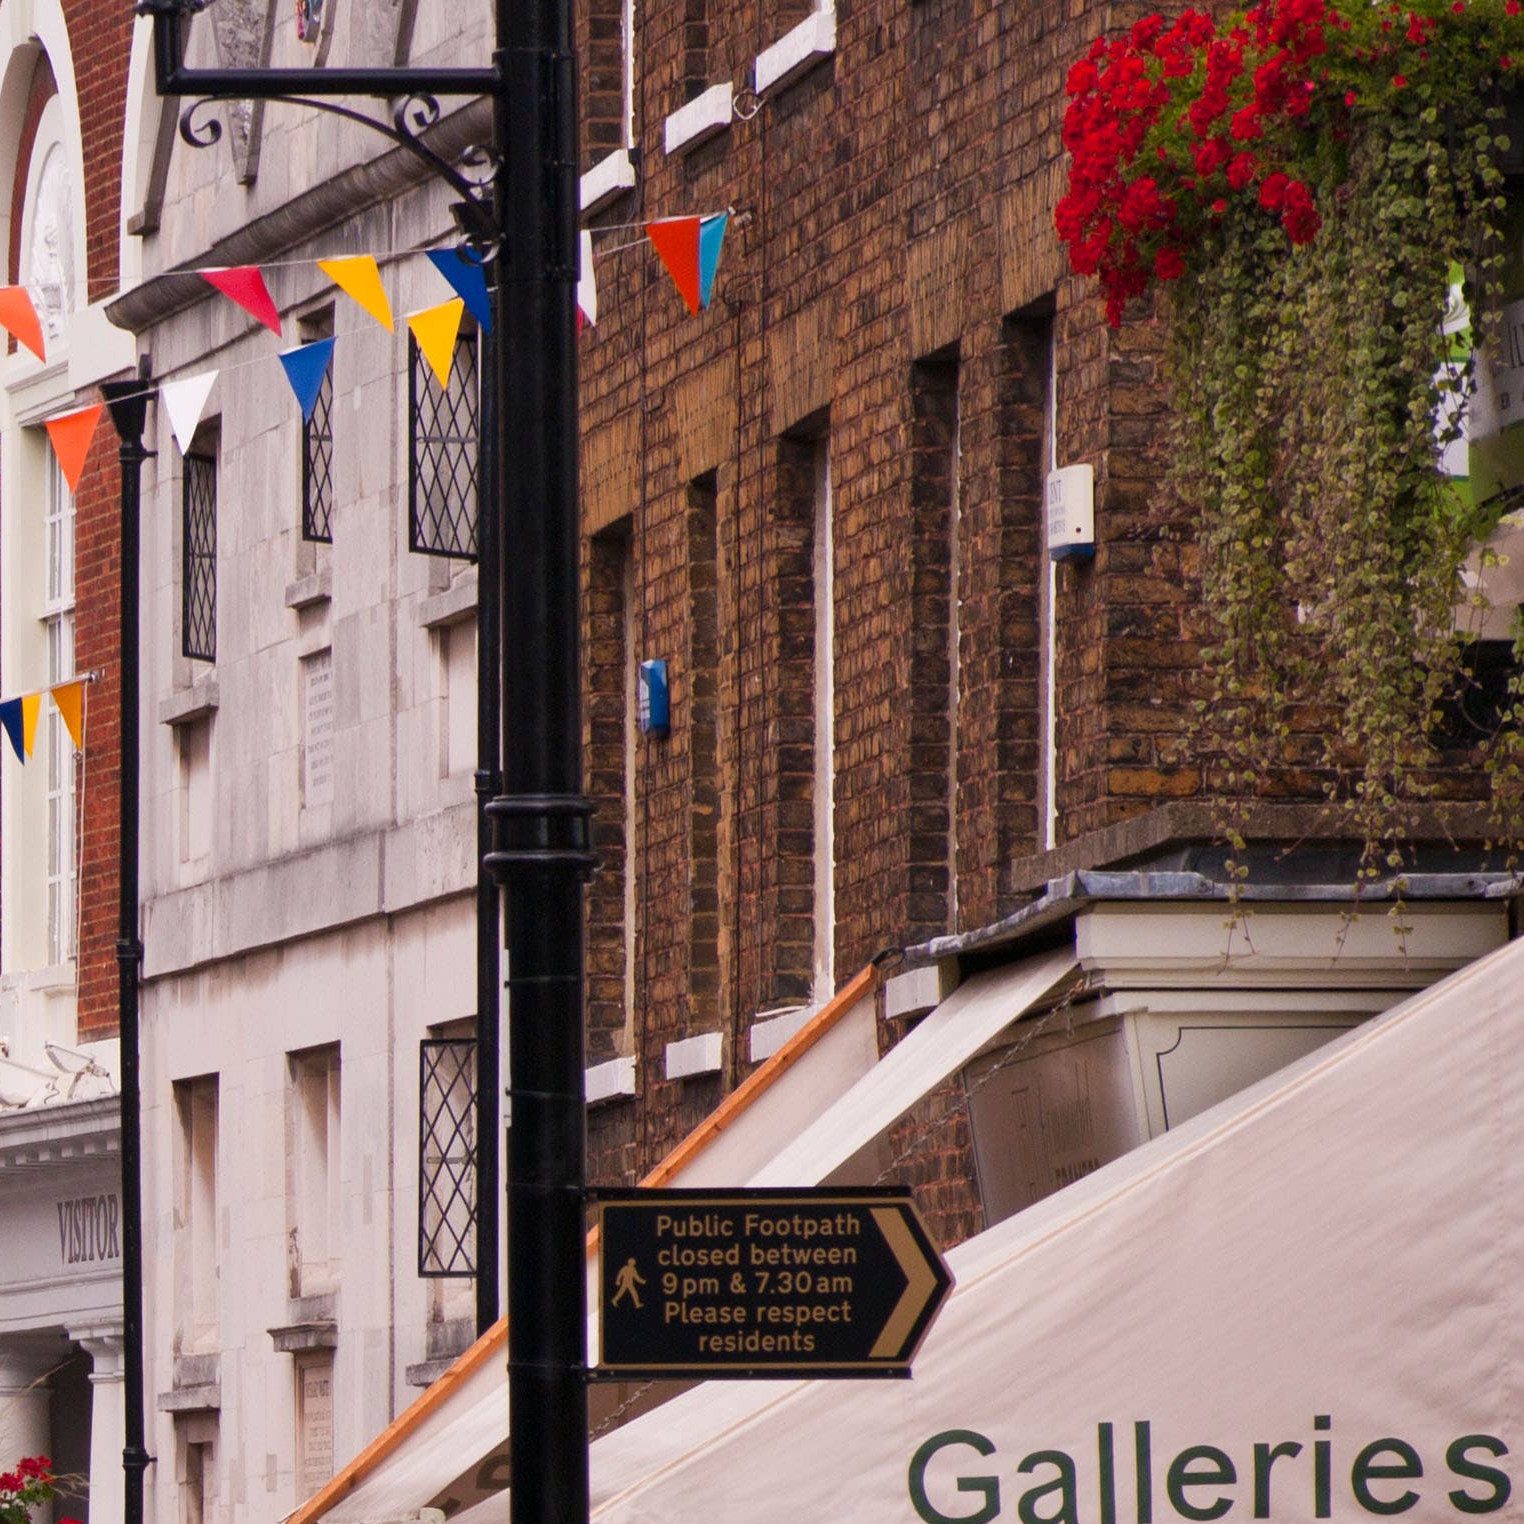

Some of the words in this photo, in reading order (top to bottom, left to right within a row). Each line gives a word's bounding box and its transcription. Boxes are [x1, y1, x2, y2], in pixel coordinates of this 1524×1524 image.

[57, 1193, 119, 1265] VISITOR
[656, 1215, 734, 1237] Public
[745, 1213, 860, 1240] Footpath
[657, 1243, 740, 1266] closed
[750, 1243, 857, 1266] between
[730, 1272, 746, 1294] &
[664, 1301, 747, 1324] Please
[756, 1300, 852, 1327] respect
[698, 1330, 816, 1352] residents
